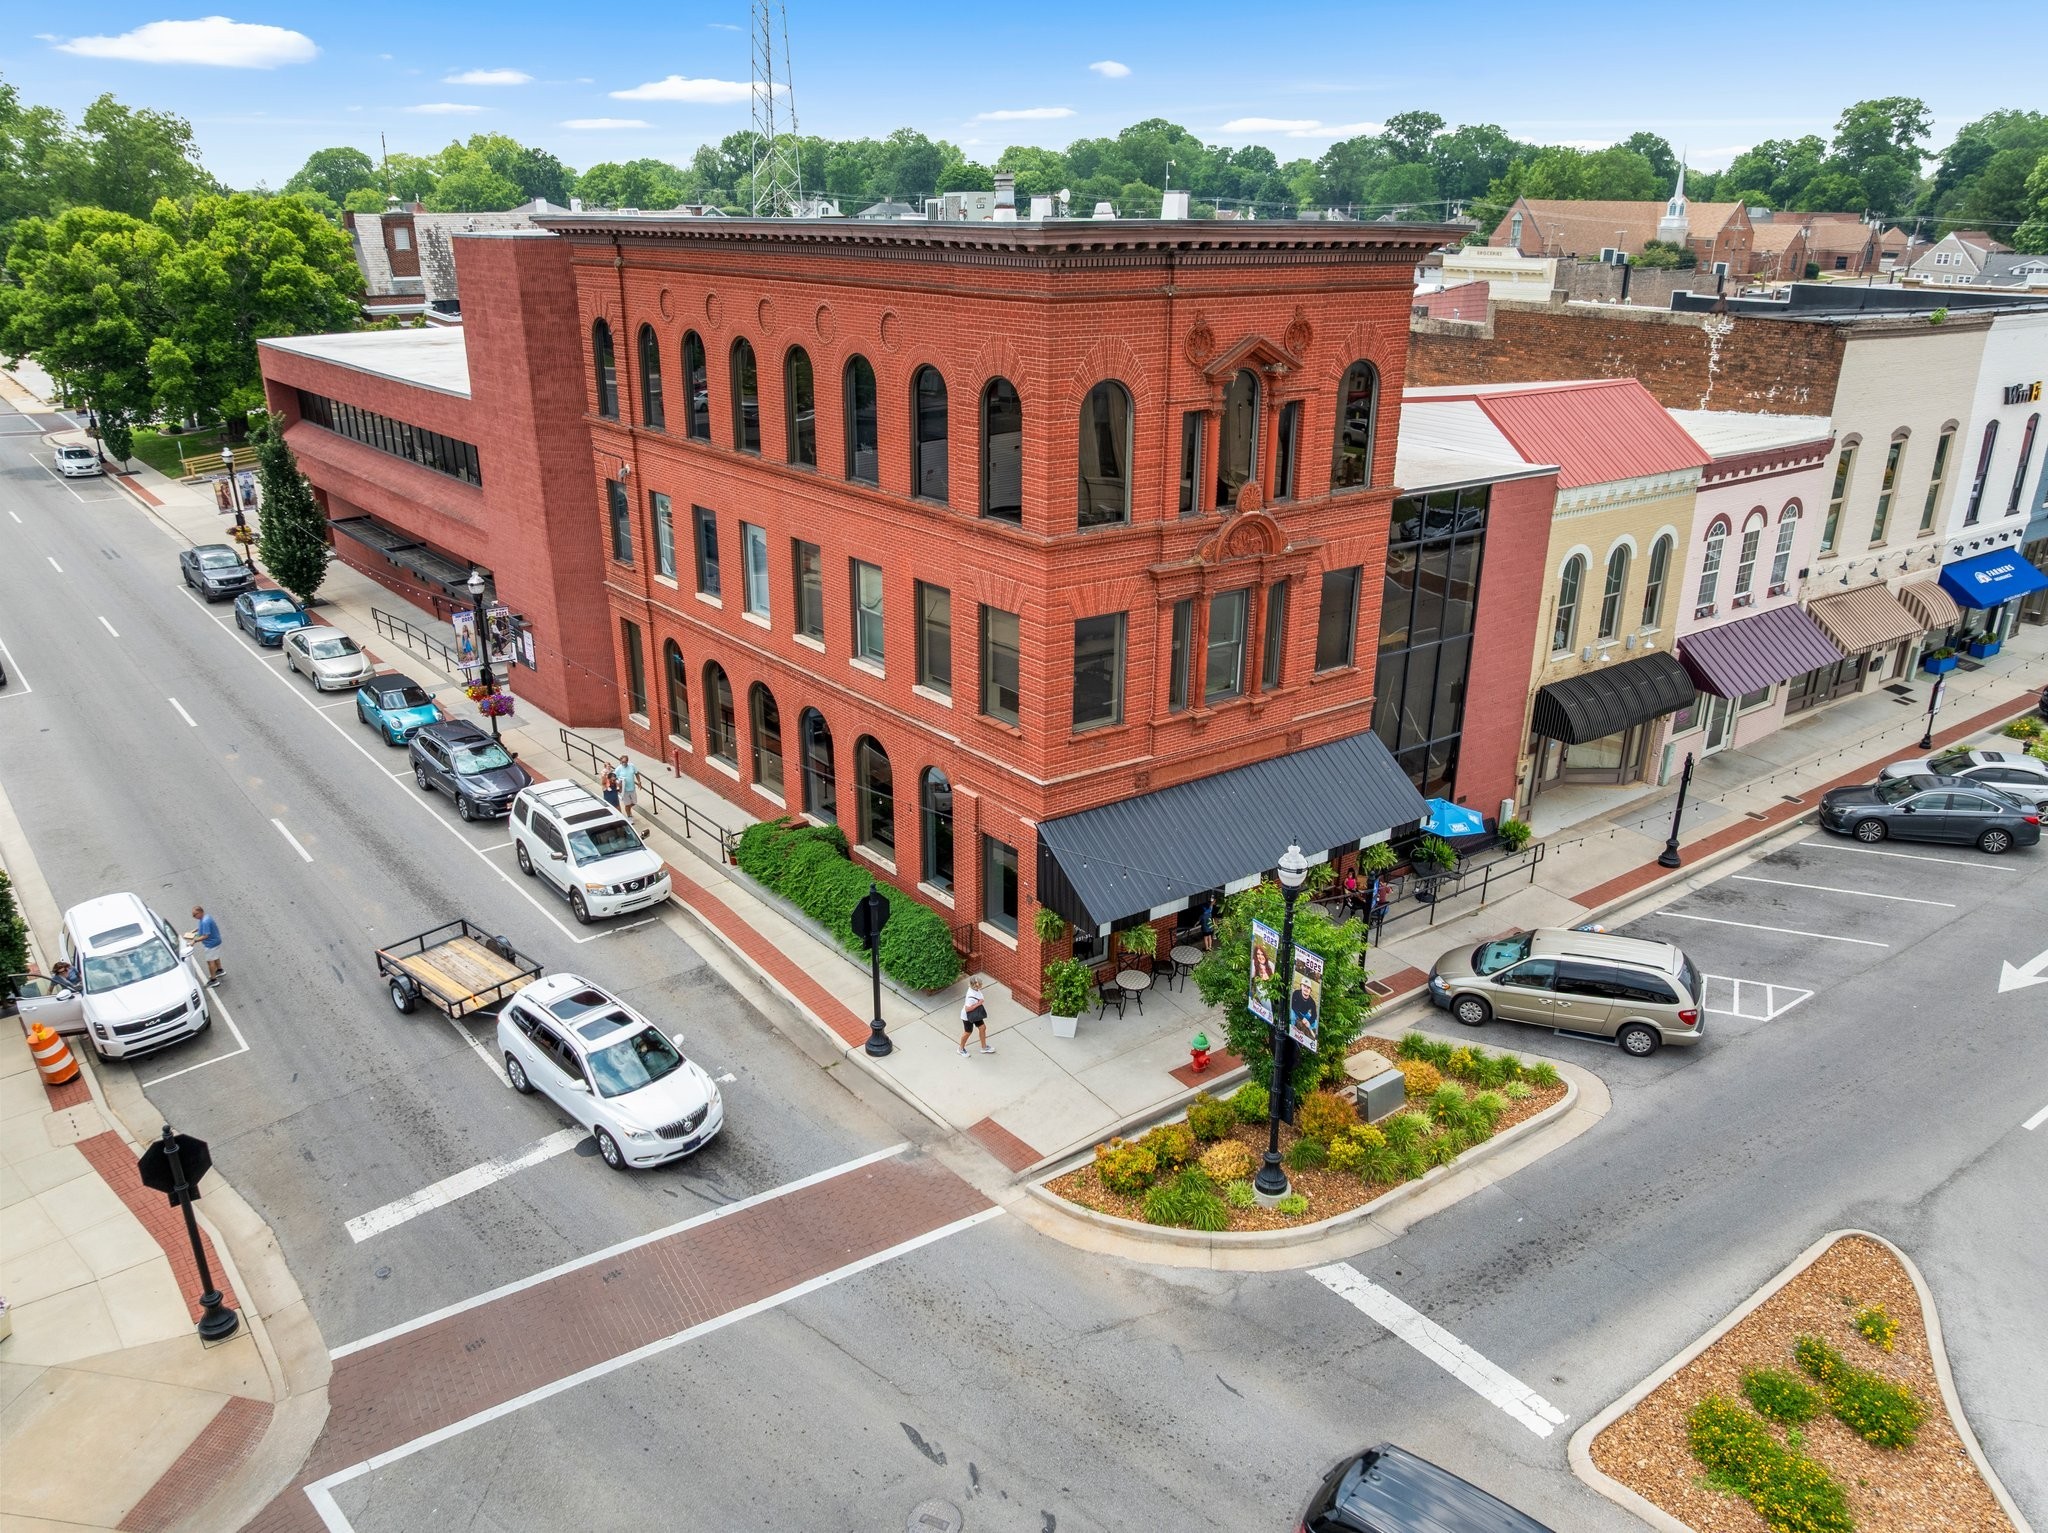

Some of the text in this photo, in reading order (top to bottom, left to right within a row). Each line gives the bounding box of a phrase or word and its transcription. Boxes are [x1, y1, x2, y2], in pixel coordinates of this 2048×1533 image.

[1986, 564, 2015, 576] FARMERS
[1263, 934, 1278, 947] 2025
[1306, 958, 1322, 973] 2025
